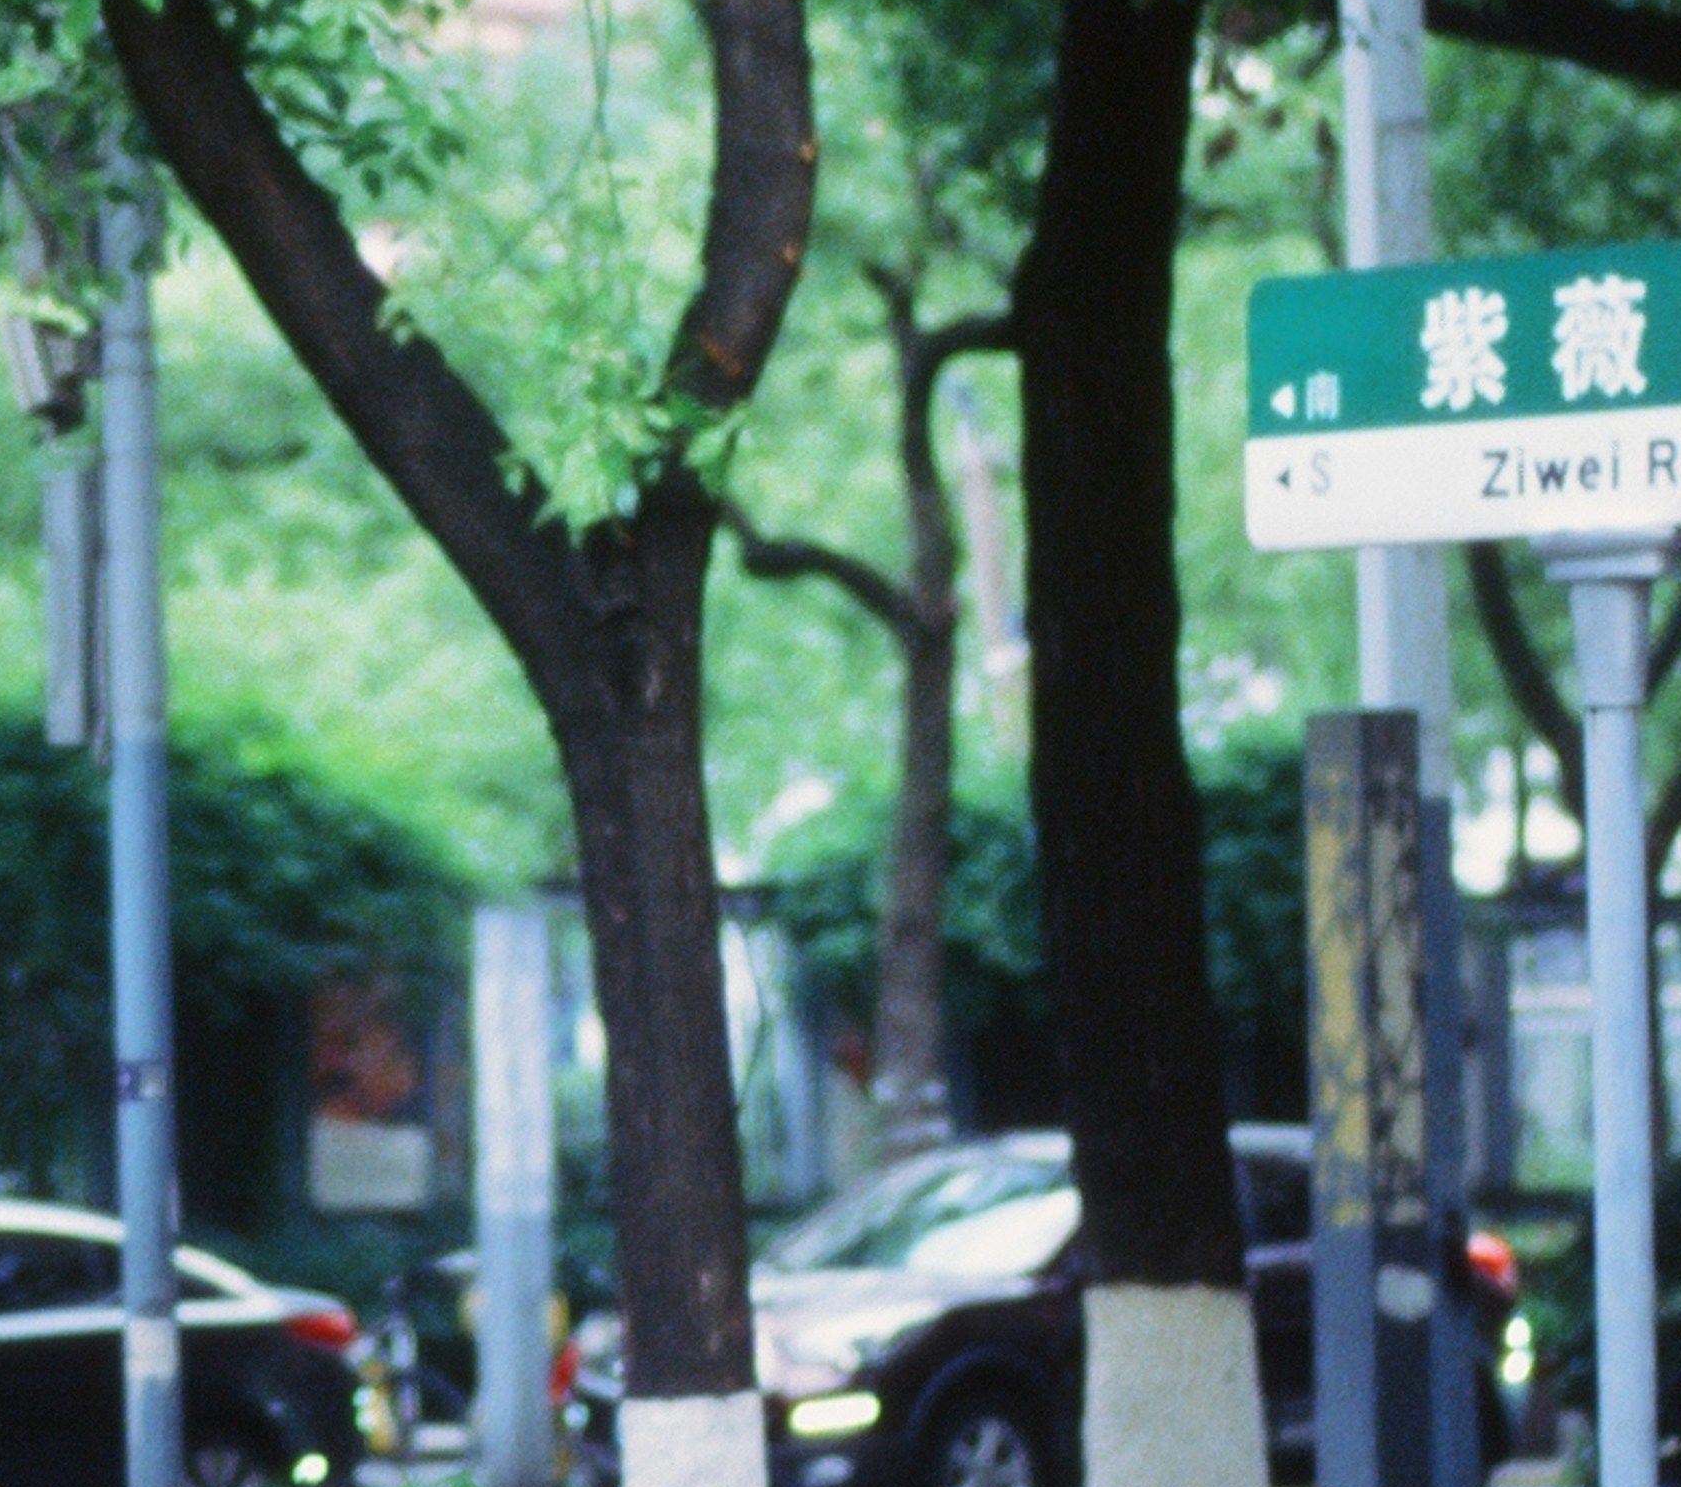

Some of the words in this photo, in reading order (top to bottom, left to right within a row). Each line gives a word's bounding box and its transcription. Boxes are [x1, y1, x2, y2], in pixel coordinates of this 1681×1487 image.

[1305, 371, 1340, 421] 南
[1310, 449, 1333, 496] S
[1480, 441, 1621, 498] Ziwei
